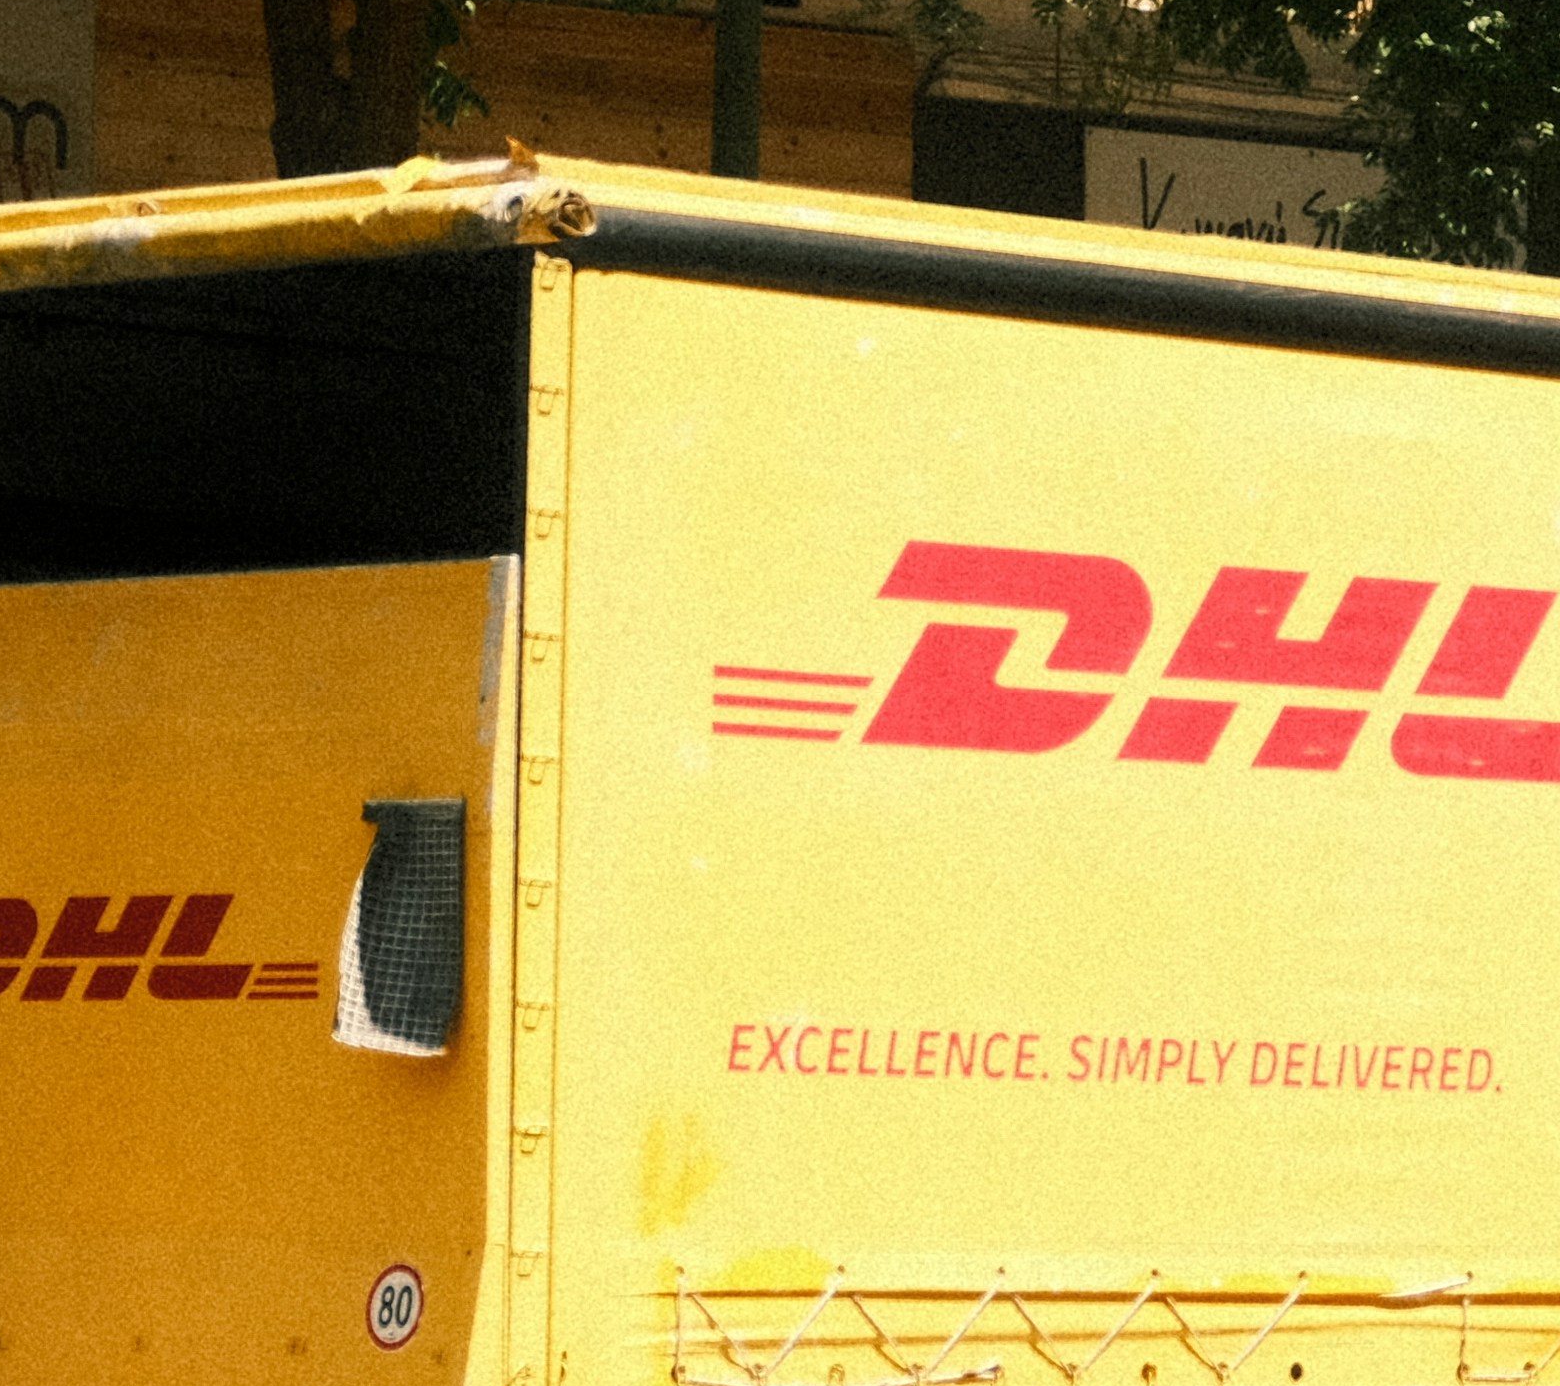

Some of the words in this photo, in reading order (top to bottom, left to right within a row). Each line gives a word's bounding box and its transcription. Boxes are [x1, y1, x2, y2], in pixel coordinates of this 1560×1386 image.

[725, 1023, 1050, 1082] EXCELLENCE.
[1067, 1033, 1238, 1085] SIMPLY
[1249, 1040, 1505, 1095] DELIVERED.
[378, 1284, 413, 1328] 80
